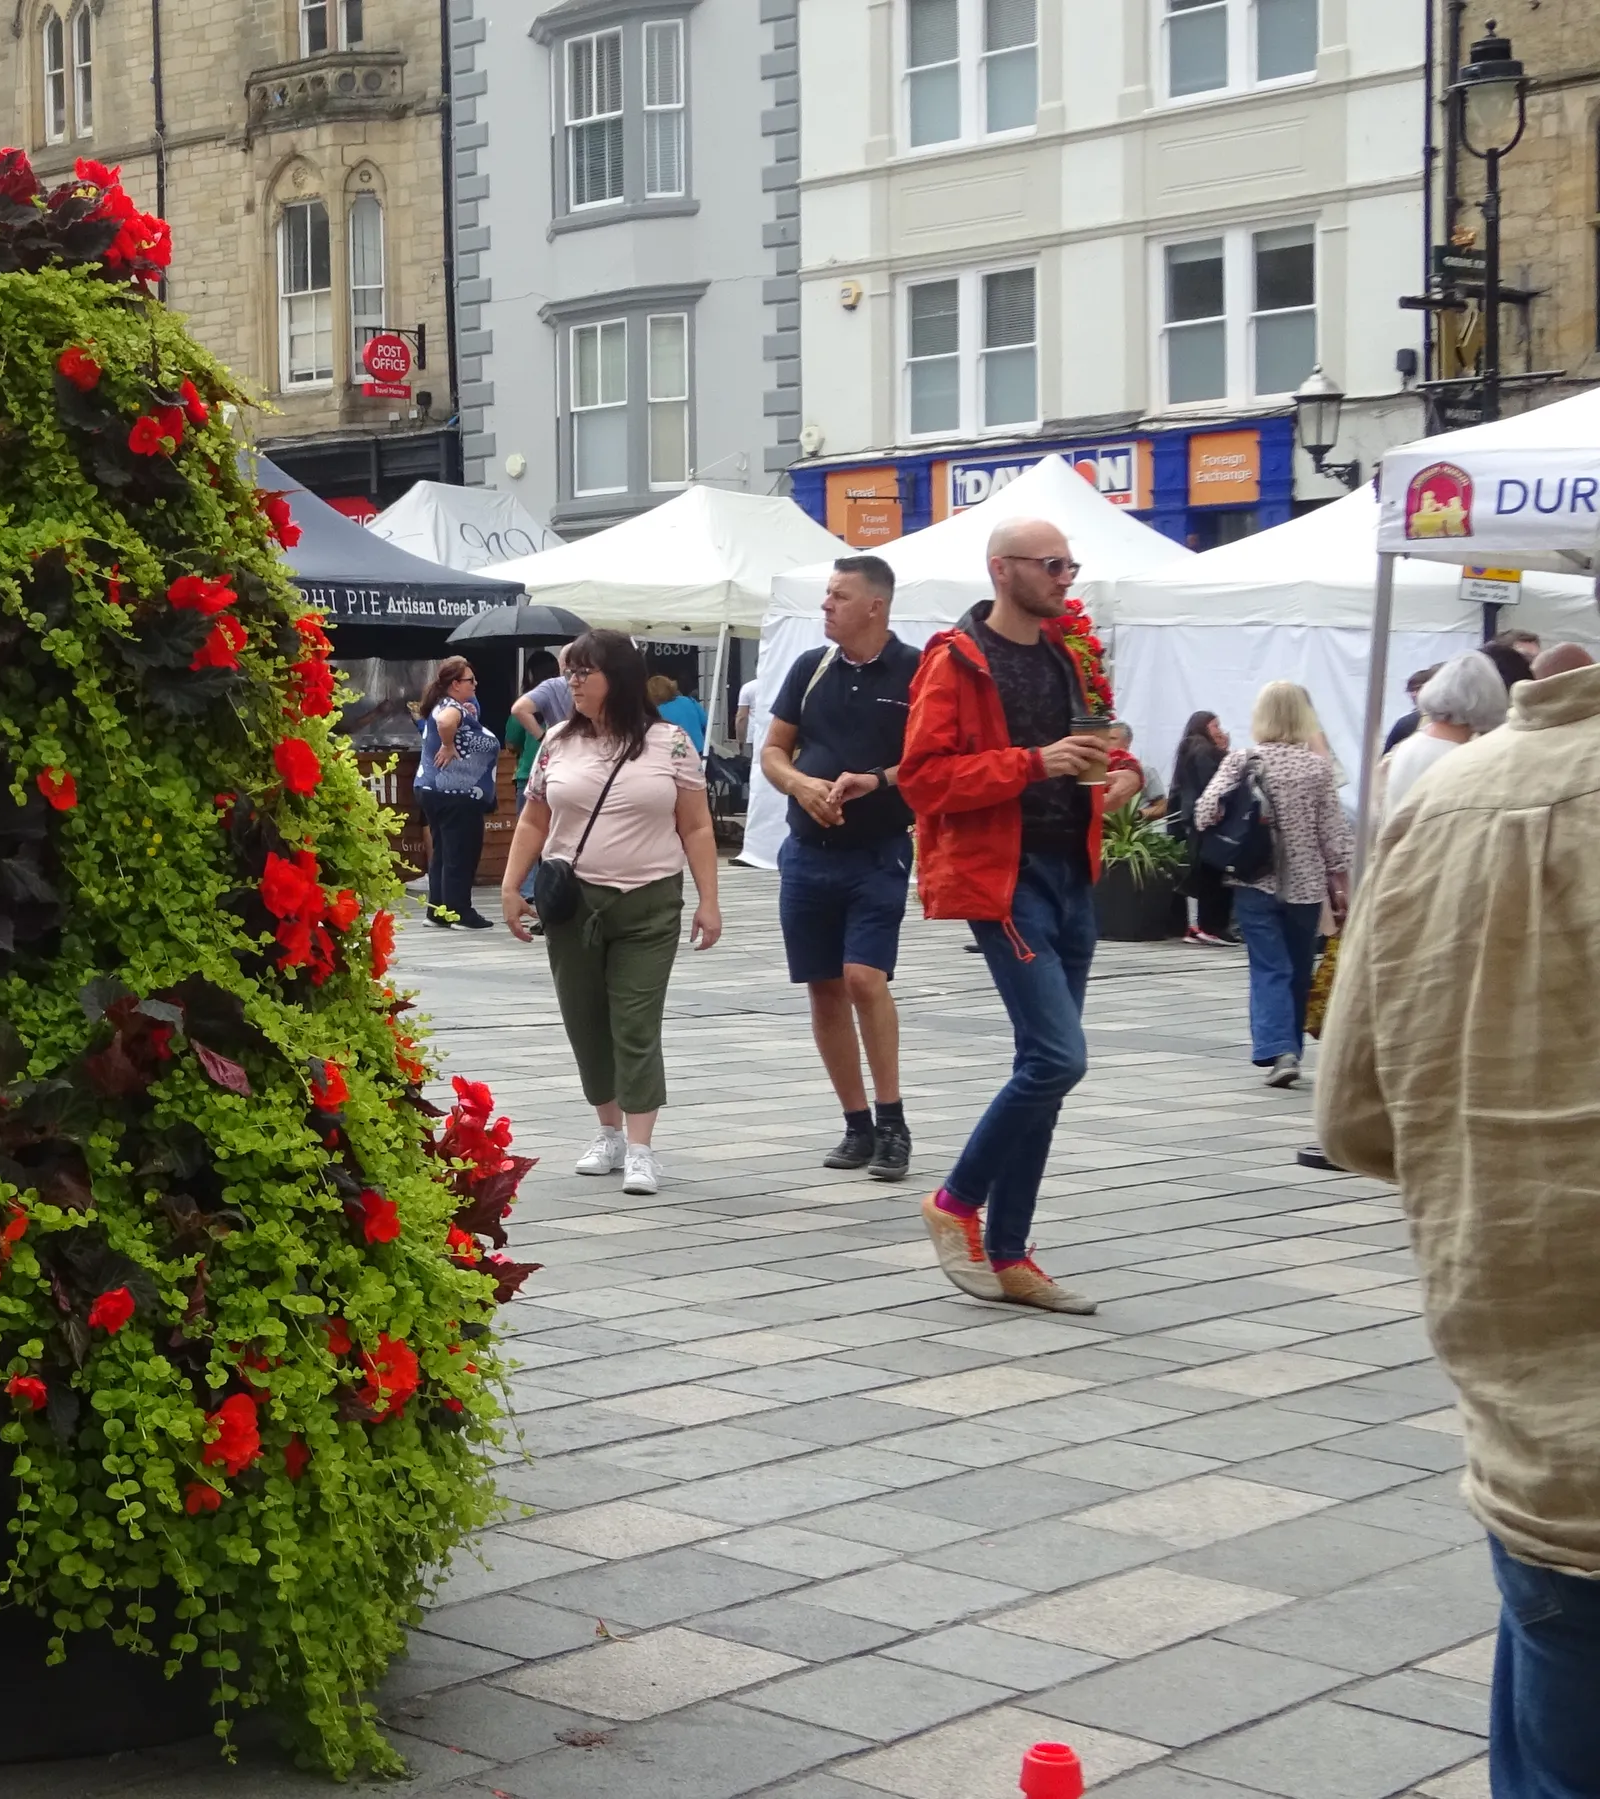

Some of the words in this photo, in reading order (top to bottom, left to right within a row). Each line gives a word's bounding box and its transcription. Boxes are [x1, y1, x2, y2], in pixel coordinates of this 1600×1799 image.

[378, 345, 401, 358] POST
[372, 357, 406, 371] OFFICE
[375, 386, 388, 394] Travel
[1202, 454, 1247, 468] Foreign
[966, 455, 1131, 503] DAON
[1196, 469, 1252, 484] Exchange
[846, 486, 877, 498] Travel
[1497, 478, 1598, 515] DUR
[862, 514, 888, 523] Travel
[858, 526, 891, 537] Agents
[345, 589, 382, 615] PIE
[386, 596, 435, 615] Artisan
[438, 599, 475, 617] Greek
